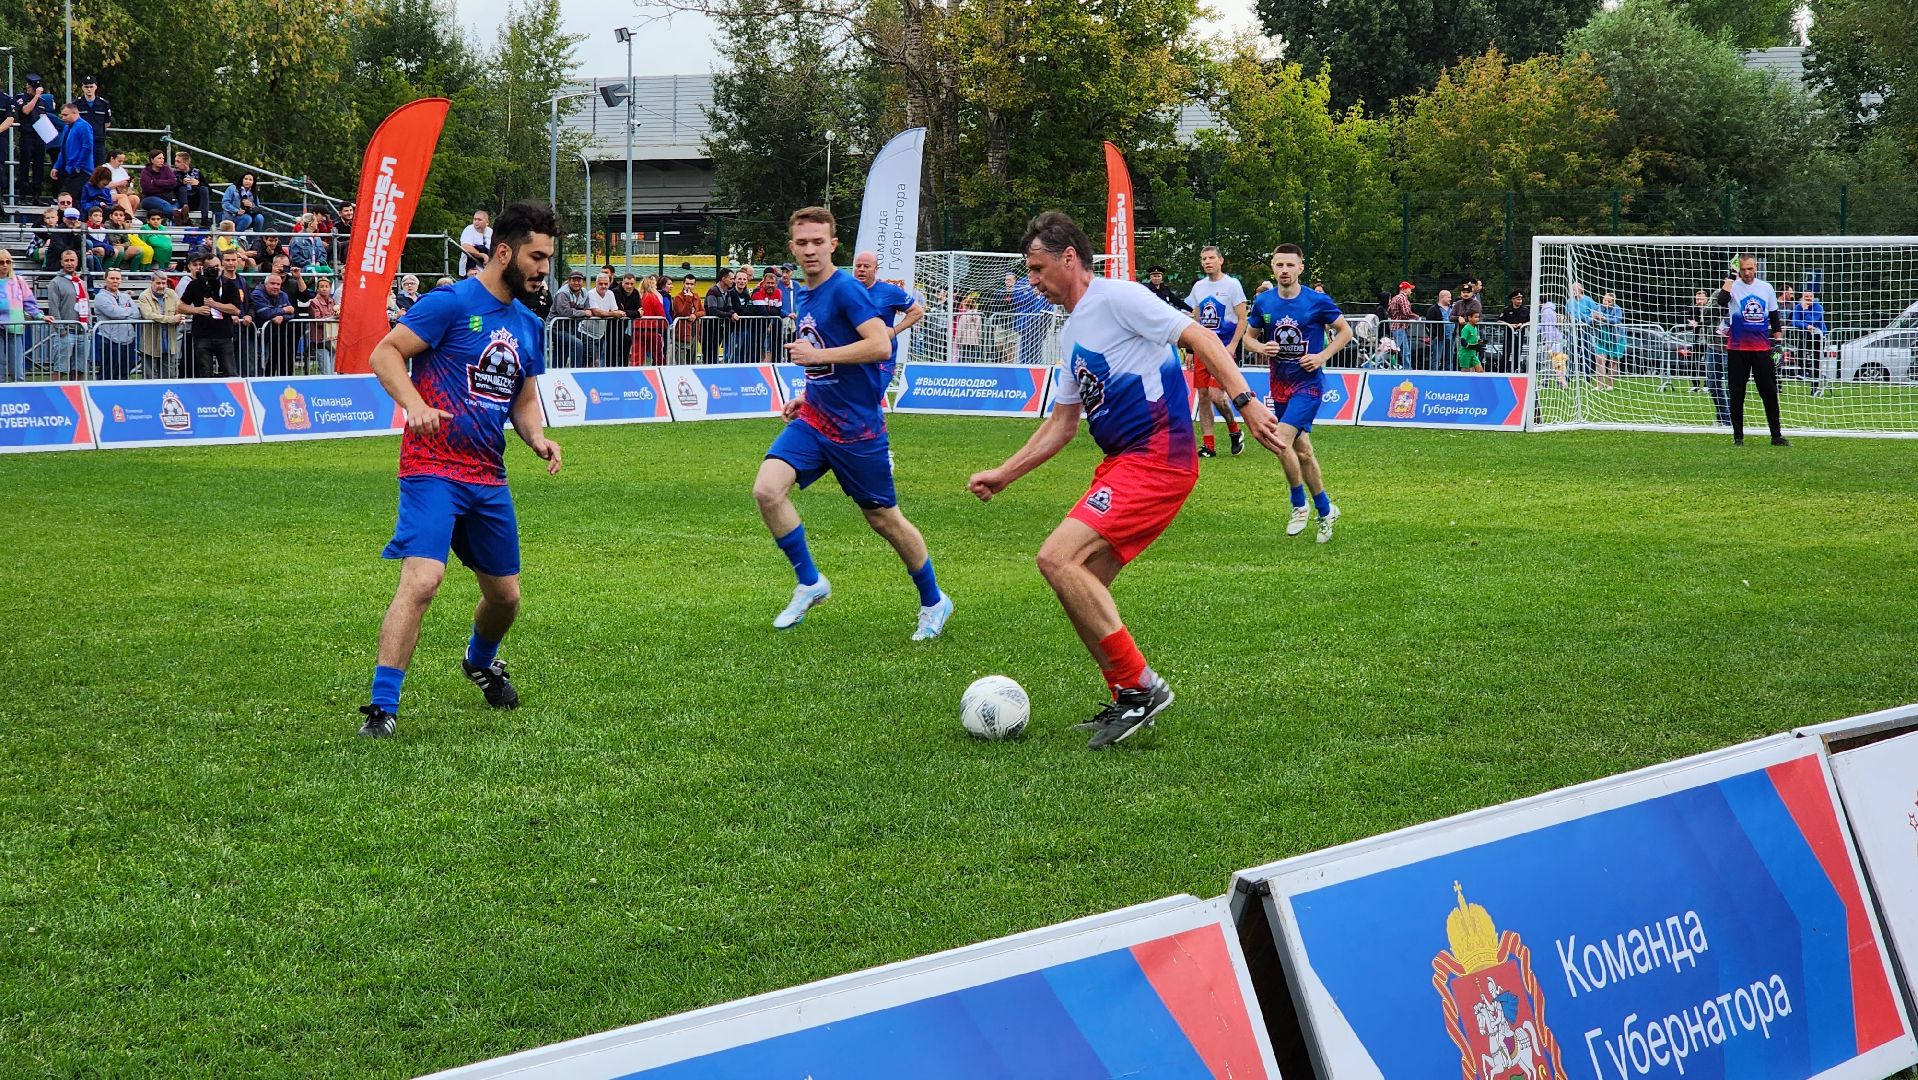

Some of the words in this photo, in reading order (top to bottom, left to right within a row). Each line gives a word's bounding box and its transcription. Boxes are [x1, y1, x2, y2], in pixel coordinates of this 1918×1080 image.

[361, 156, 397, 272] МОСОБЛ
[374, 183, 404, 274] СПОРТ
[889, 183, 909, 270] Губернатора
[915, 377, 997, 388] #ВЫХОДИВОДВОР
[911, 387, 1027, 400] #КОМАНДАГУБЕРНАТОРА
[1425, 390, 1469, 402] Команда
[311, 396, 353, 408] Команда
[1422, 404, 1488, 417] Губернатора
[314, 411, 375, 425] Губернатора
[1555, 910, 1708, 997] Команда
[1584, 974, 1792, 1080] Губернатора
